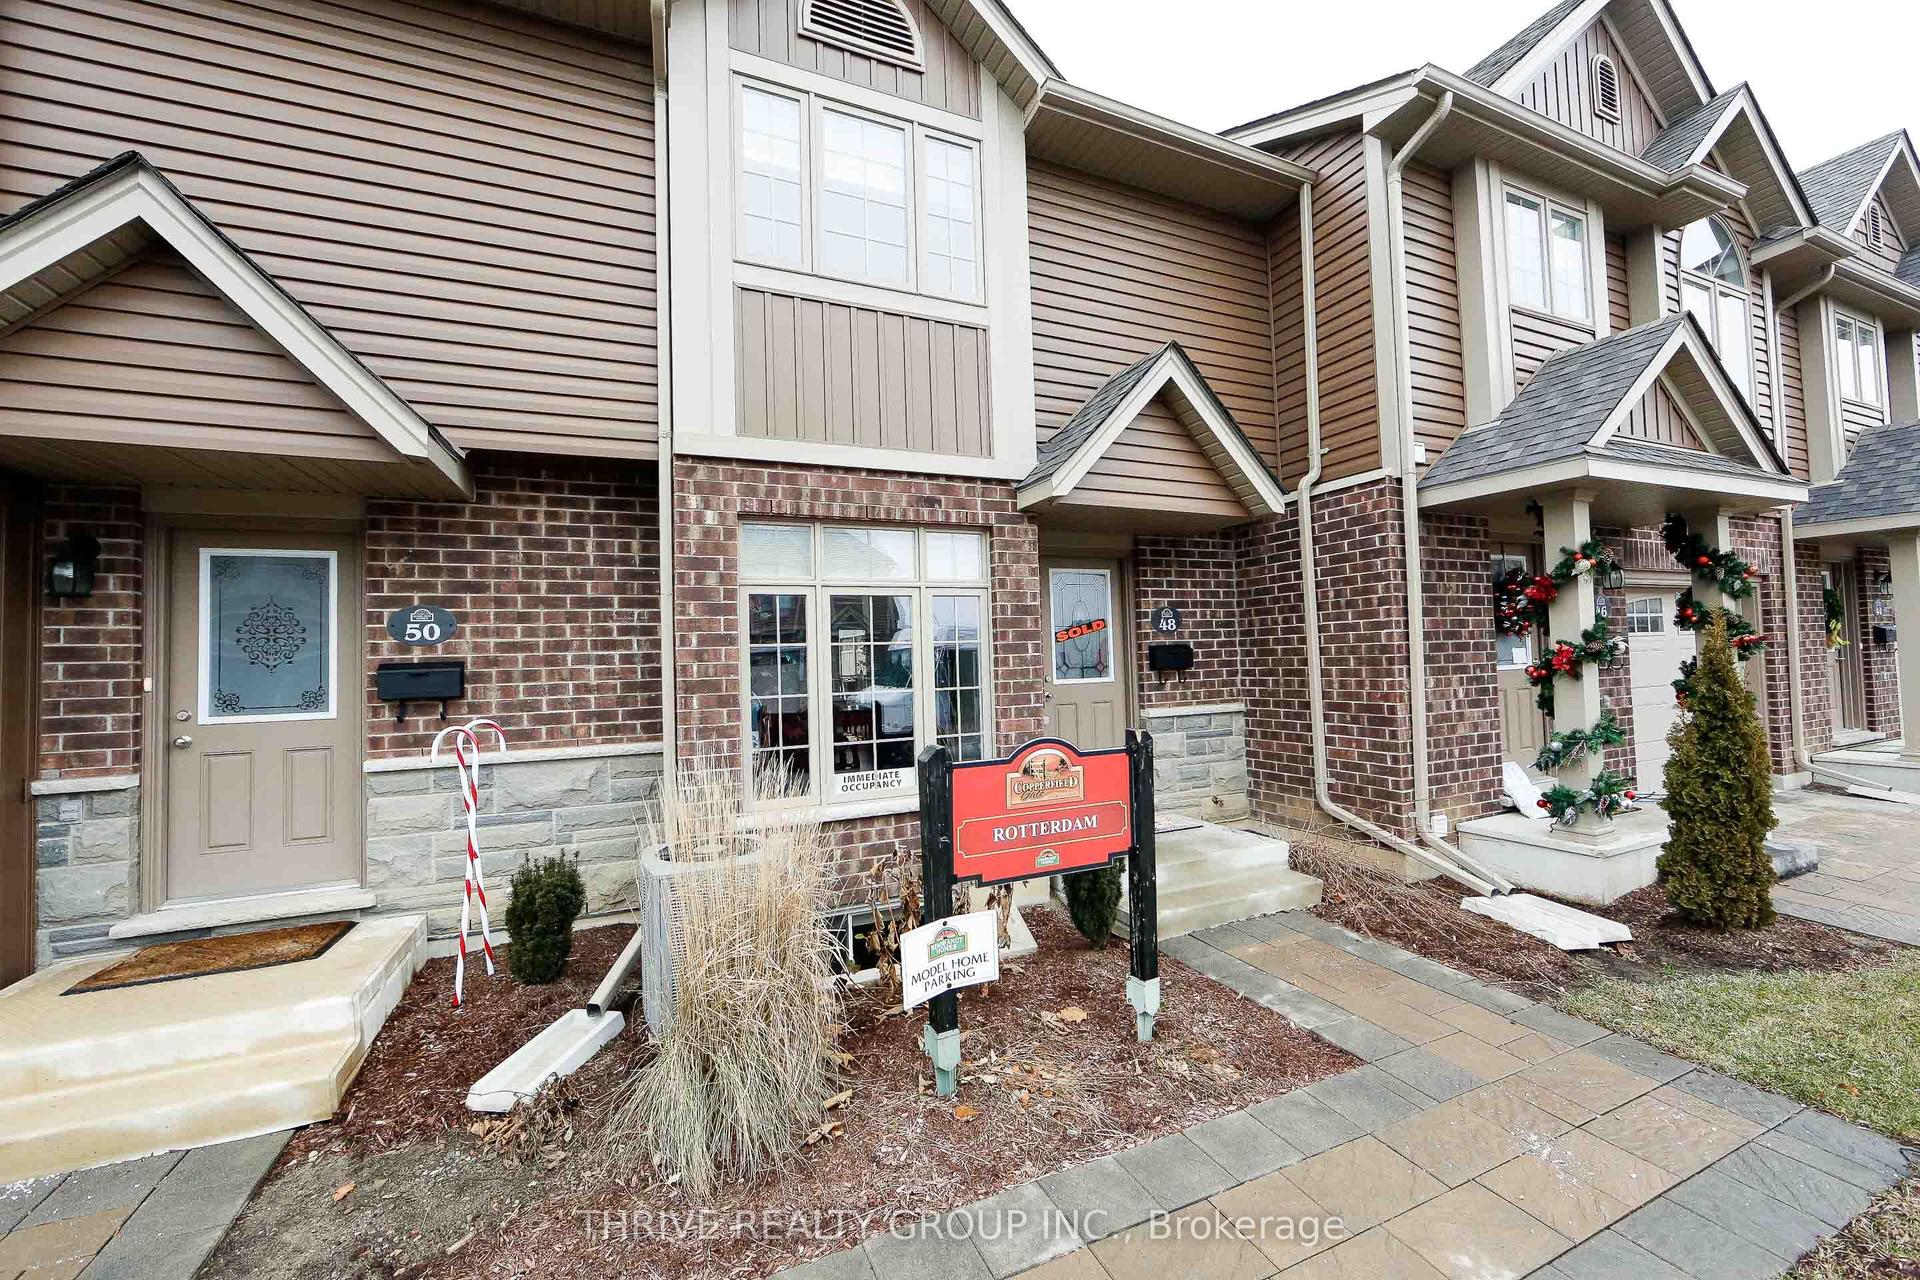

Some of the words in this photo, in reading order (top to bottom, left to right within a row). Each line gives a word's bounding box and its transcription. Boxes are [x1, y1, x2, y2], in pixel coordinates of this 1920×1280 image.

[404, 623, 440, 641] 50
[1056, 620, 1105, 641] SOLD
[1159, 618, 1176, 631] 48
[841, 779, 902, 792] OCCUPANCY
[843, 771, 900, 783] IMMEDIATE
[1013, 776, 1078, 795] COPPERFIELD
[992, 814, 1098, 843] ROTTERDAM
[911, 962, 946, 986] MODEL
[951, 952, 989, 969] HOME
[924, 967, 976, 992] PARKING
